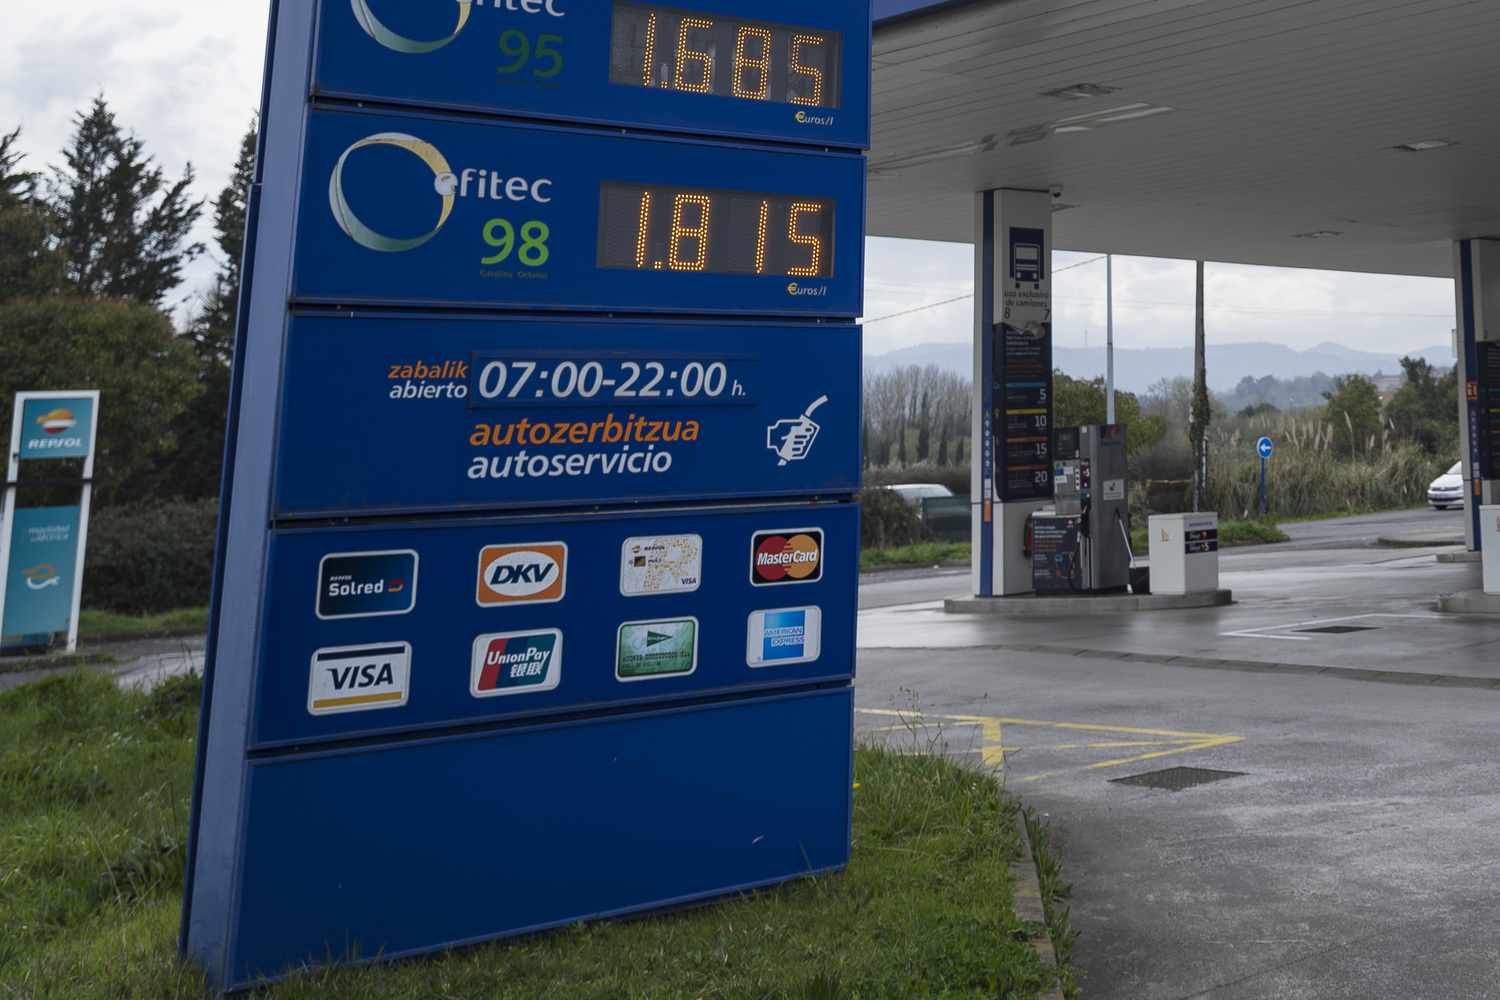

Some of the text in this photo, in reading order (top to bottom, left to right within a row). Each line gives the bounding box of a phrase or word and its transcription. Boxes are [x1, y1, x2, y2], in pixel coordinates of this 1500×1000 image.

[496, 28, 564, 78] 95
[643, 13, 824, 107] 1.685
[635, 191, 822, 276] 1.815
[480, 218, 550, 267] 98
[480, 269, 514, 278] Gasolina
[1004, 290, 1049, 299] uso exclusivo
[1005, 298, 1048, 308] de camiones
[1004, 307, 1051, 320] 8 7
[387, 361, 747, 398] zabalik 07:00-22:00 h.
[389, 380, 468, 399] abierto
[1039, 388, 1047, 400] 5
[1034, 415, 1047, 427] 10
[468, 413, 700, 446] autozerbitzua
[27, 437, 83, 449] REPSOL
[1035, 443, 1048, 455] 15
[466, 444, 673, 479] autoservicio
[1034, 471, 1048, 483] 20
[1204, 541, 1210, 551] 5
[756, 549, 819, 567] MasterCard
[490, 562, 555, 585] DKV
[680, 577, 697, 585] VISA
[328, 579, 385, 597] Solred
[763, 626, 804, 638] AMERICAN
[771, 636, 806, 647] EXPRESS
[487, 646, 551, 666] UnionPay
[325, 662, 394, 690] VISA
